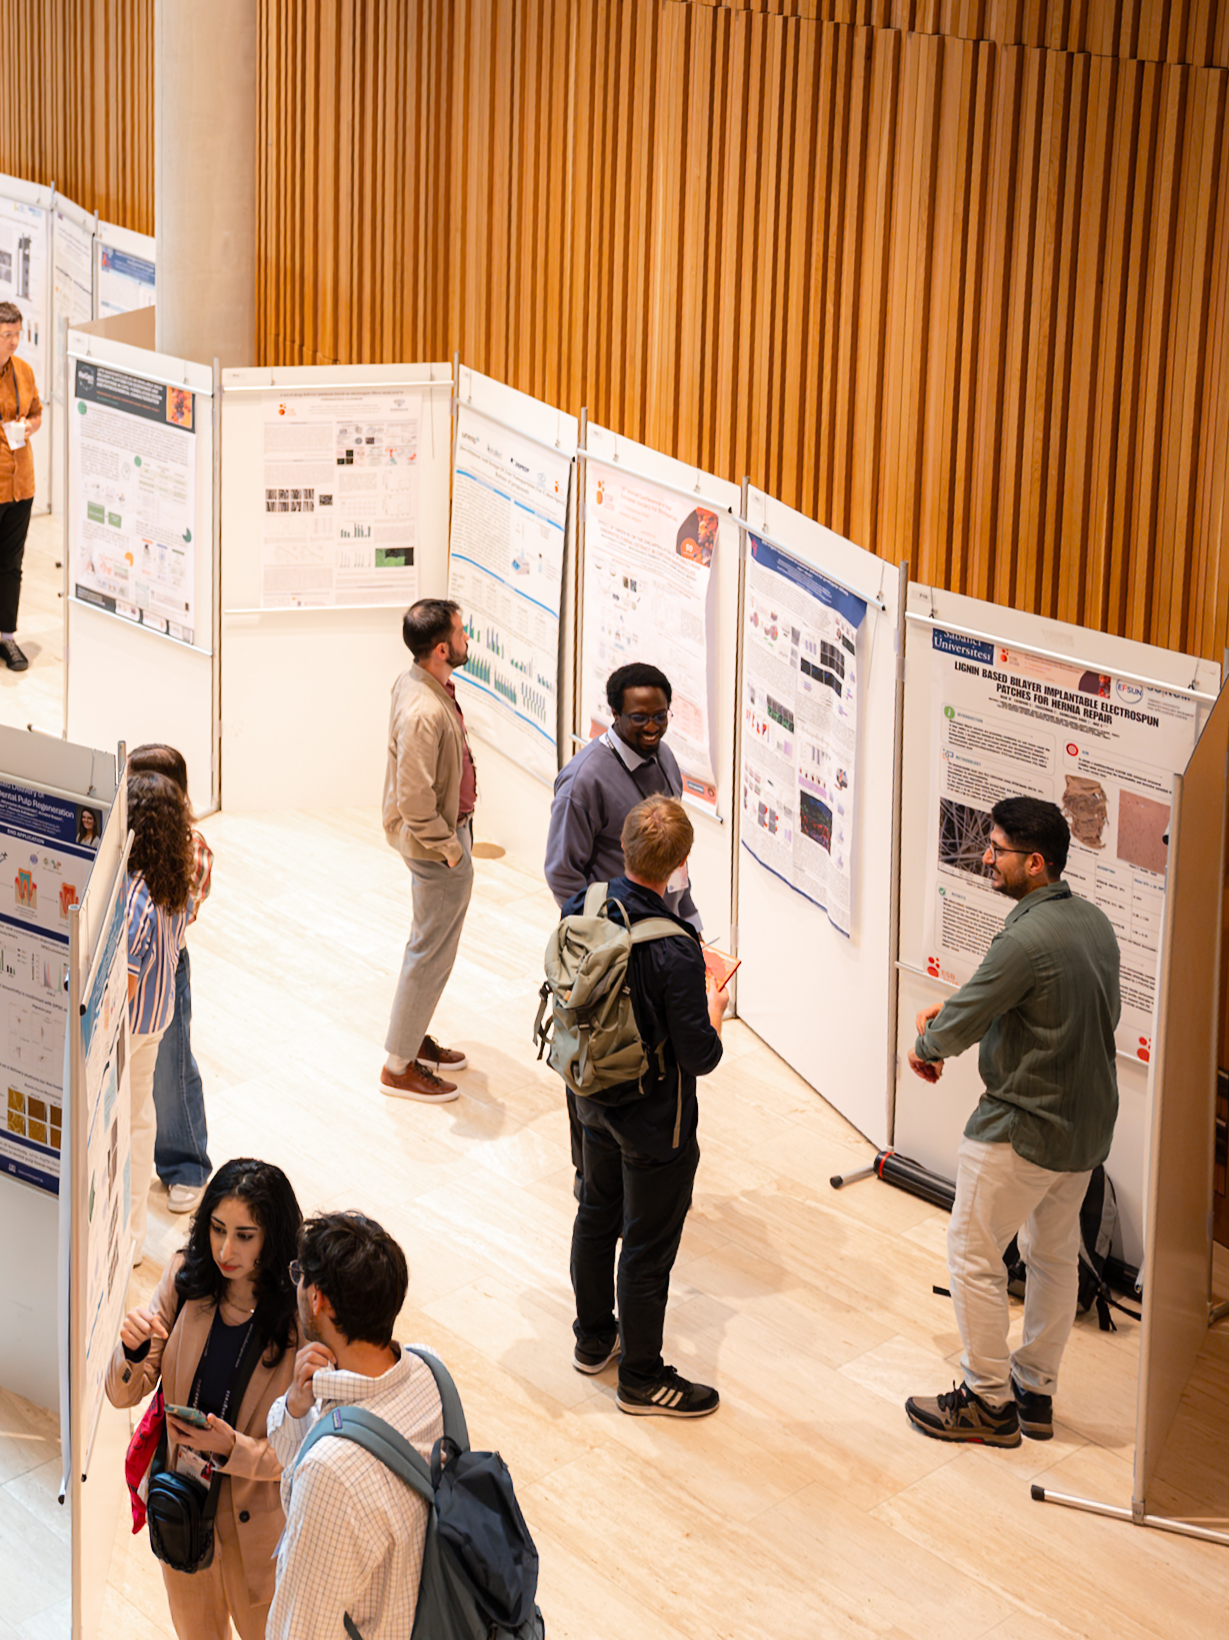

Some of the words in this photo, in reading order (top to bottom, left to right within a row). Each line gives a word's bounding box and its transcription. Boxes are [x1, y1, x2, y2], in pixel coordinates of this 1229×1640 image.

[685, 544, 693, 552] 50
[954, 660, 980, 676] LIGNIN
[981, 668, 1008, 684] BASED
[1010, 676, 1042, 693] BILAYER
[1043, 685, 1099, 709] IMPLANTABLE
[1100, 701, 1160, 728] ELECTROSPUN
[1117, 683, 1143, 696] EFSUN
[996, 683, 1031, 701] PATCHES
[1033, 693, 1049, 707] FOR
[1051, 698, 1081, 716] HERNIA
[1083, 706, 1113, 725] REPAIR
[17, 793, 32, 807] Pulp
[33, 799, 75, 819] Regeneration
[7, 828, 17, 836] END
[17, 832, 45, 844] APPLICATION
